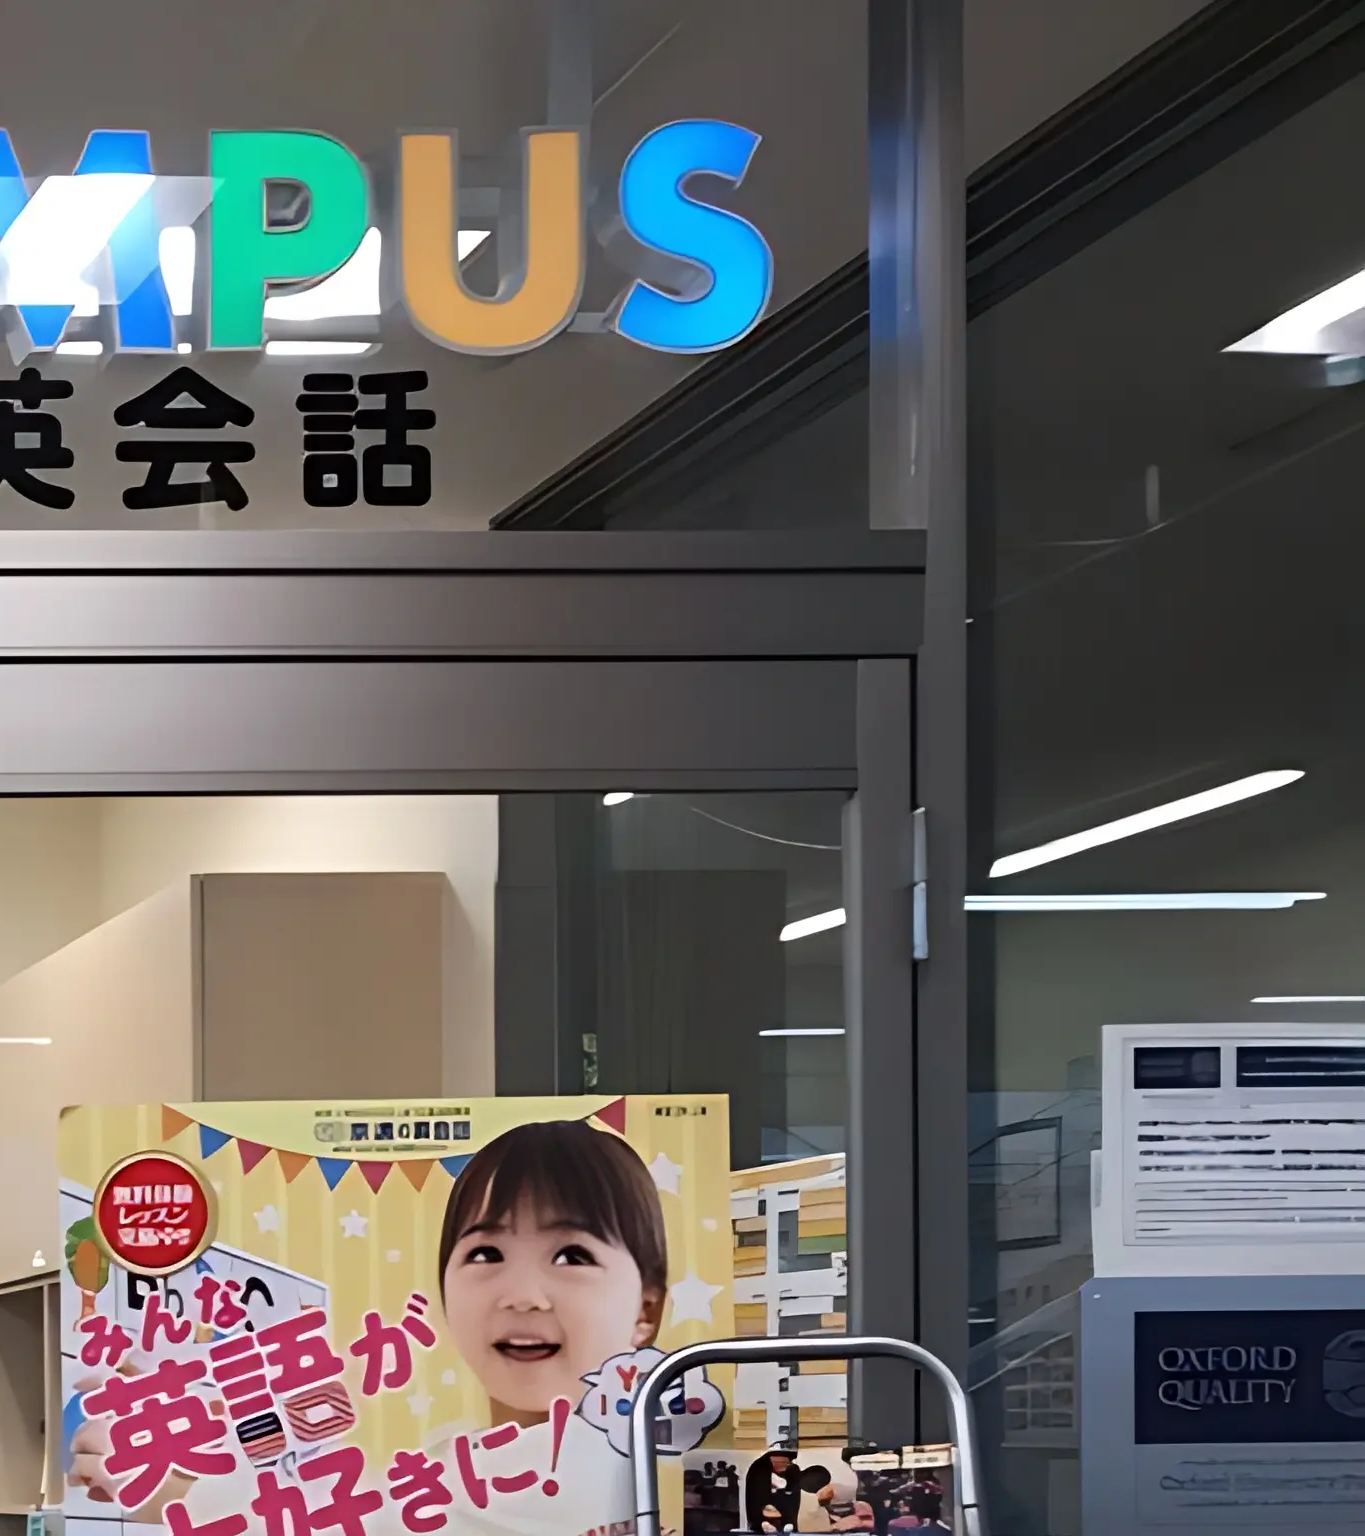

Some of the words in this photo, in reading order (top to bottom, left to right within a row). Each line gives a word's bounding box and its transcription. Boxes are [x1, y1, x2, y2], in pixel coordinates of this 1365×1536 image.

[79, 1276, 247, 1367] みんな
[1158, 1346, 1298, 1373] OXFORD
[81, 1294, 437, 1508] 英語が
[1158, 1378, 1297, 1412] QUALITY
